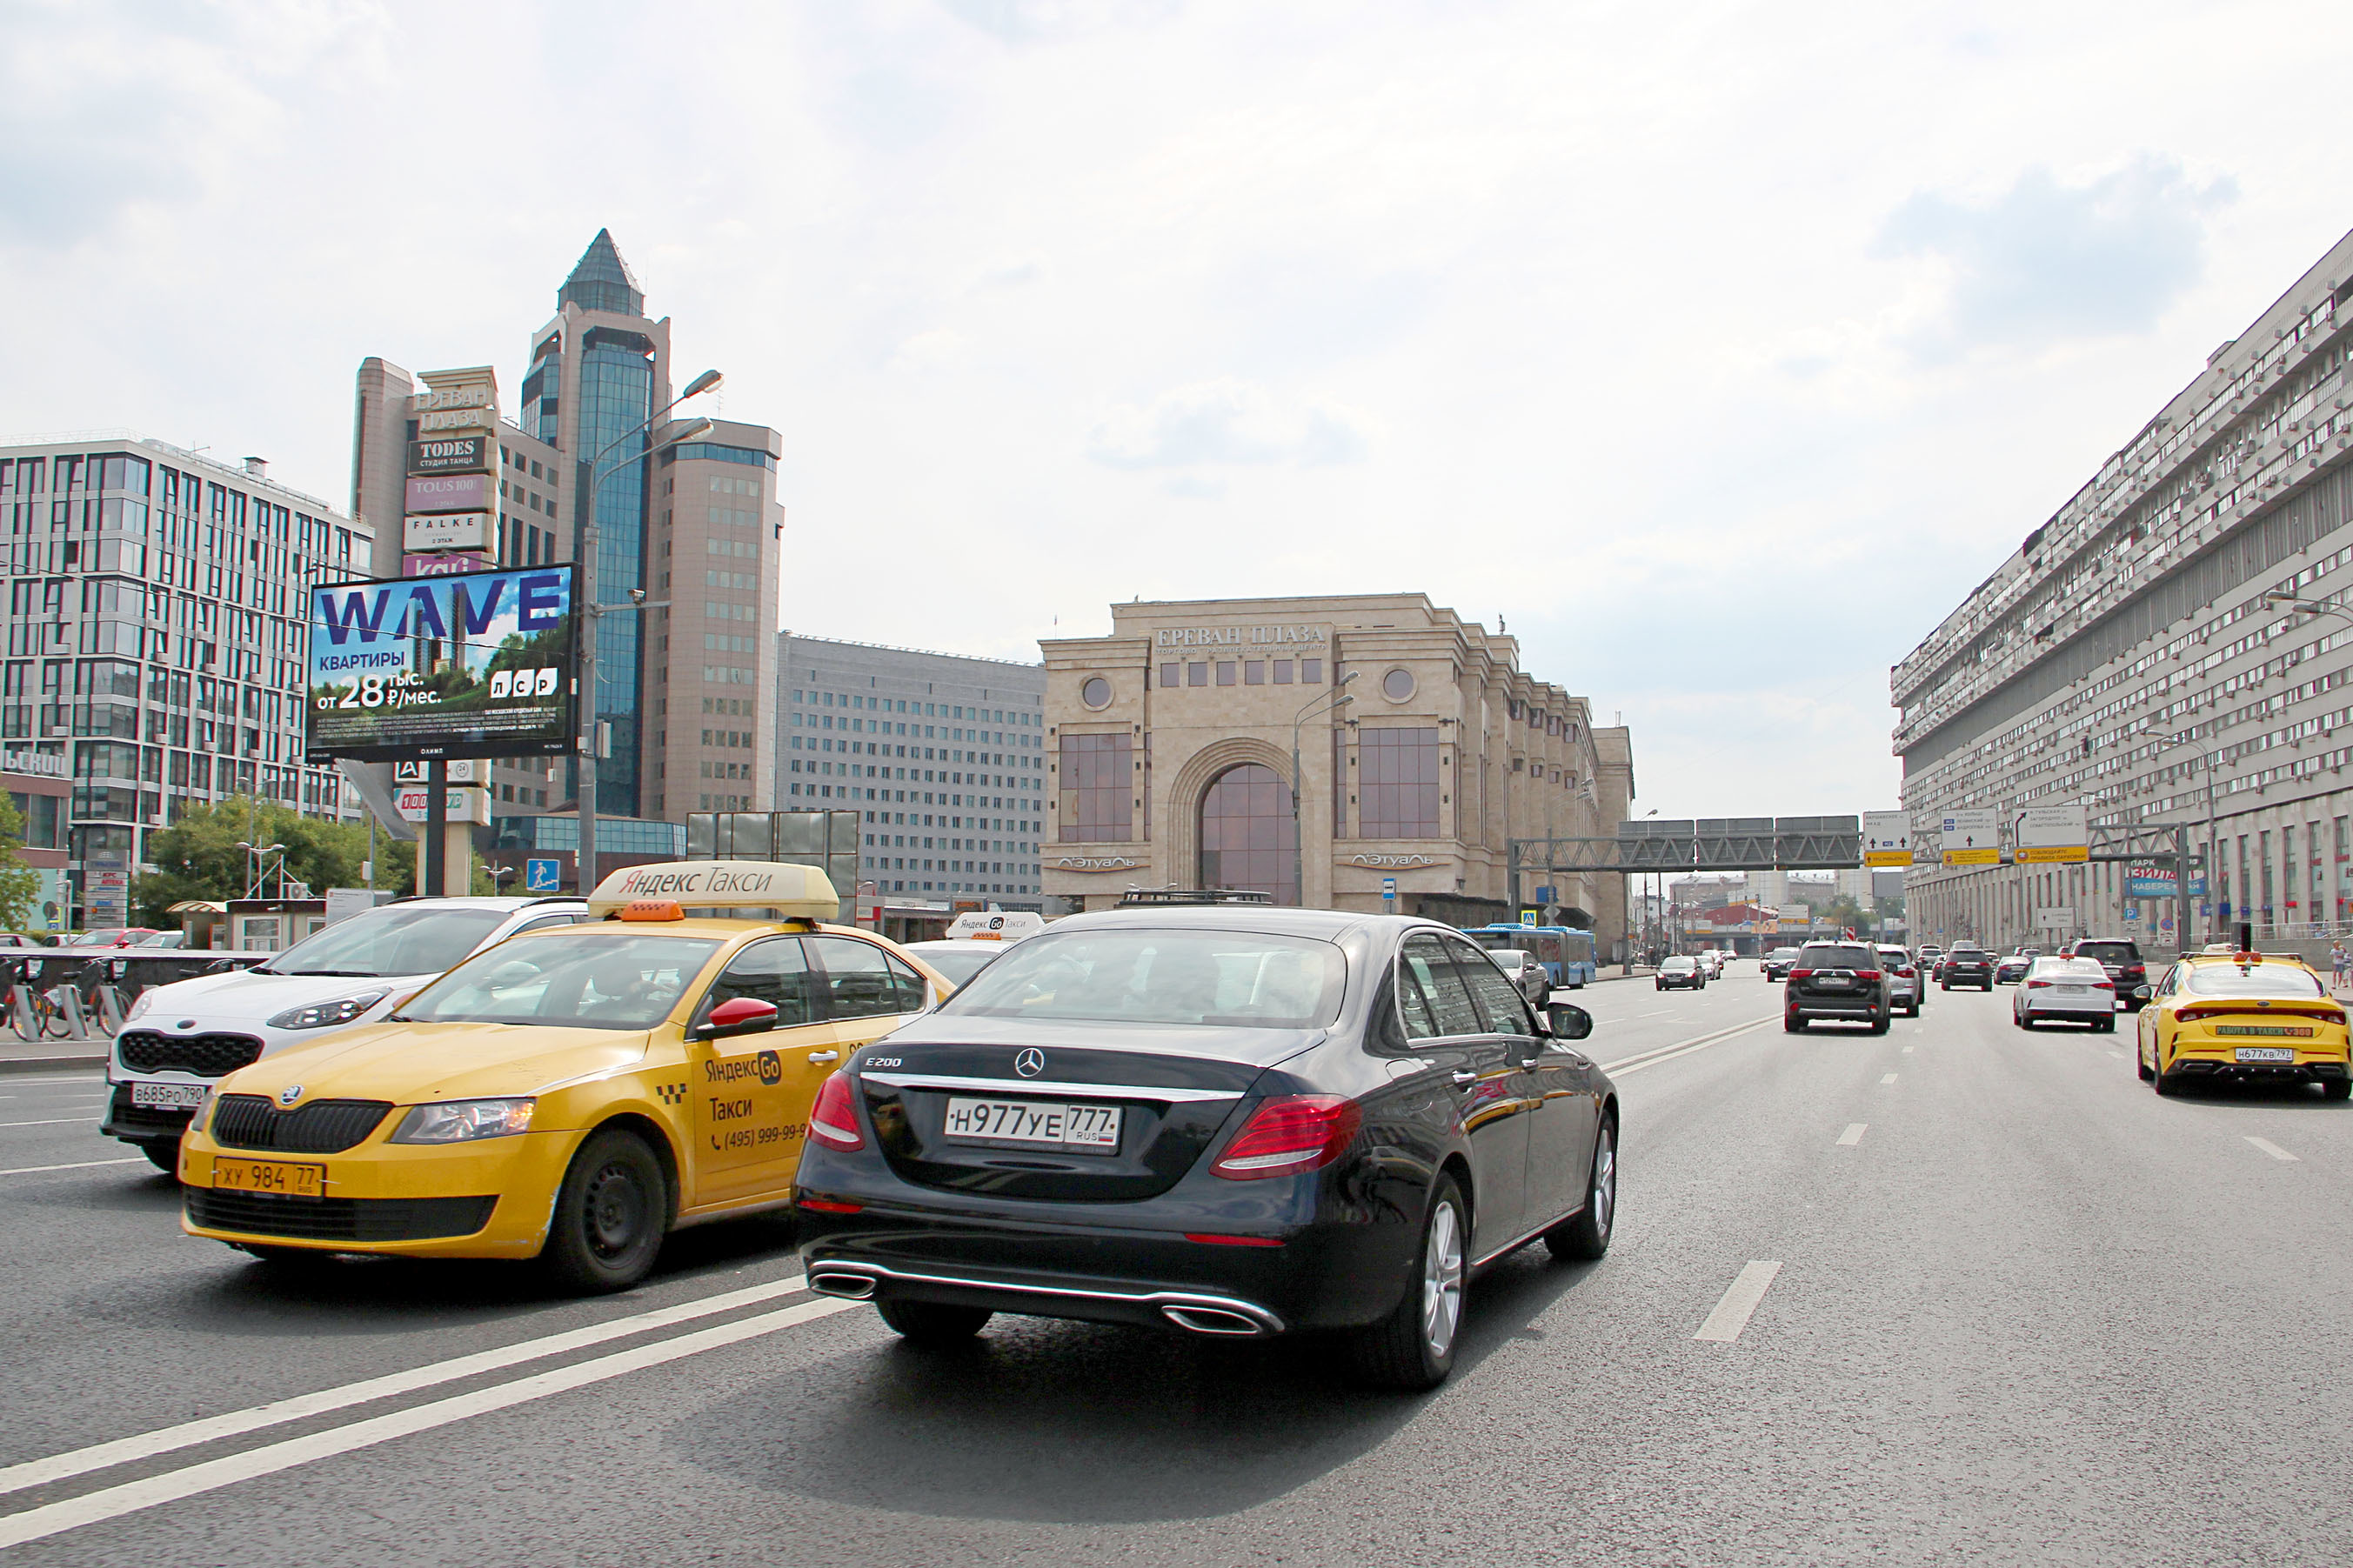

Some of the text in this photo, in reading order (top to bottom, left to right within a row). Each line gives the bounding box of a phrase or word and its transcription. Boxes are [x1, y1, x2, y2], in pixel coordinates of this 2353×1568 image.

[417, 390, 487, 410] ЕРЕВАН
[422, 410, 481, 430] ПЛАЗА
[420, 441, 475, 457] TODES
[416, 481, 454, 493] TOUS
[413, 517, 474, 530] FALKE
[320, 574, 561, 645] WAVE
[1157, 625, 1325, 647] ЕРЕВАН ПЛАЗА
[320, 651, 404, 671] КВАРТИРЫ
[317, 673, 424, 710] от 28 тыс.
[2130, 858, 2156, 867] ПАРК
[618, 866, 772, 897] Яндекс Такси
[960, 918, 1026, 930] Яндекс Go Такси
[2257, 1027, 2283, 1036] ТАКСИ
[705, 1056, 779, 1084] Яндекс Go
[136, 1086, 203, 1104] В685РО 790
[709, 1097, 752, 1122] Такси
[955, 1104, 1113, 1138] Н977УЕ 777
[725, 1123, 806, 1151] (495) 999-99-9
[1076, 1132, 1098, 1141] RUS
[223, 1165, 315, 1190] ХУ 984 77
